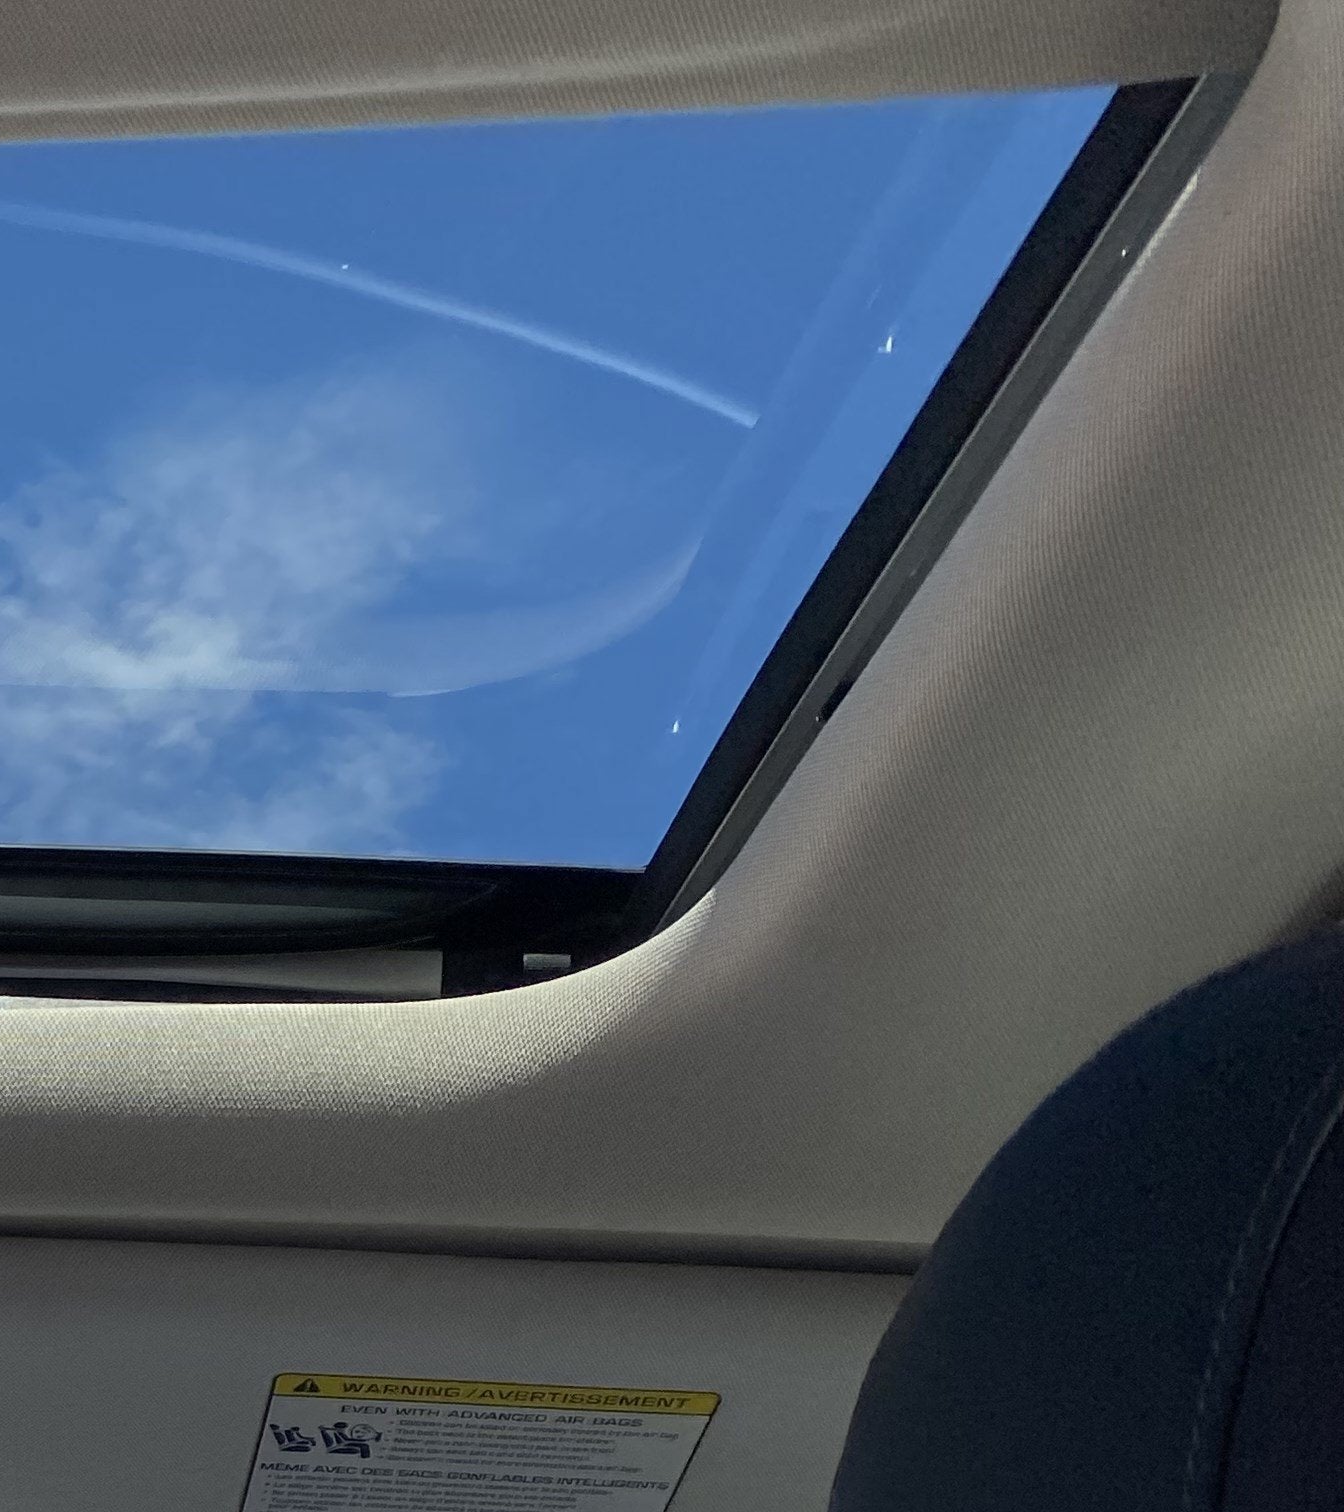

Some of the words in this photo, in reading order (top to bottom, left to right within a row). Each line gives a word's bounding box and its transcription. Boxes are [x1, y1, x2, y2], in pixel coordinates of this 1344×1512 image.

[341, 1382, 461, 1399] WARNING
[478, 1388, 690, 1409] AVERTISSEMENT
[340, 1405, 387, 1416] EVEN
[394, 1406, 442, 1418] WITH
[447, 1409, 547, 1423] ADVANCED
[554, 1414, 585, 1425] AIR
[592, 1416, 644, 1428] BAGS
[311, 1464, 359, 1476] AVEC
